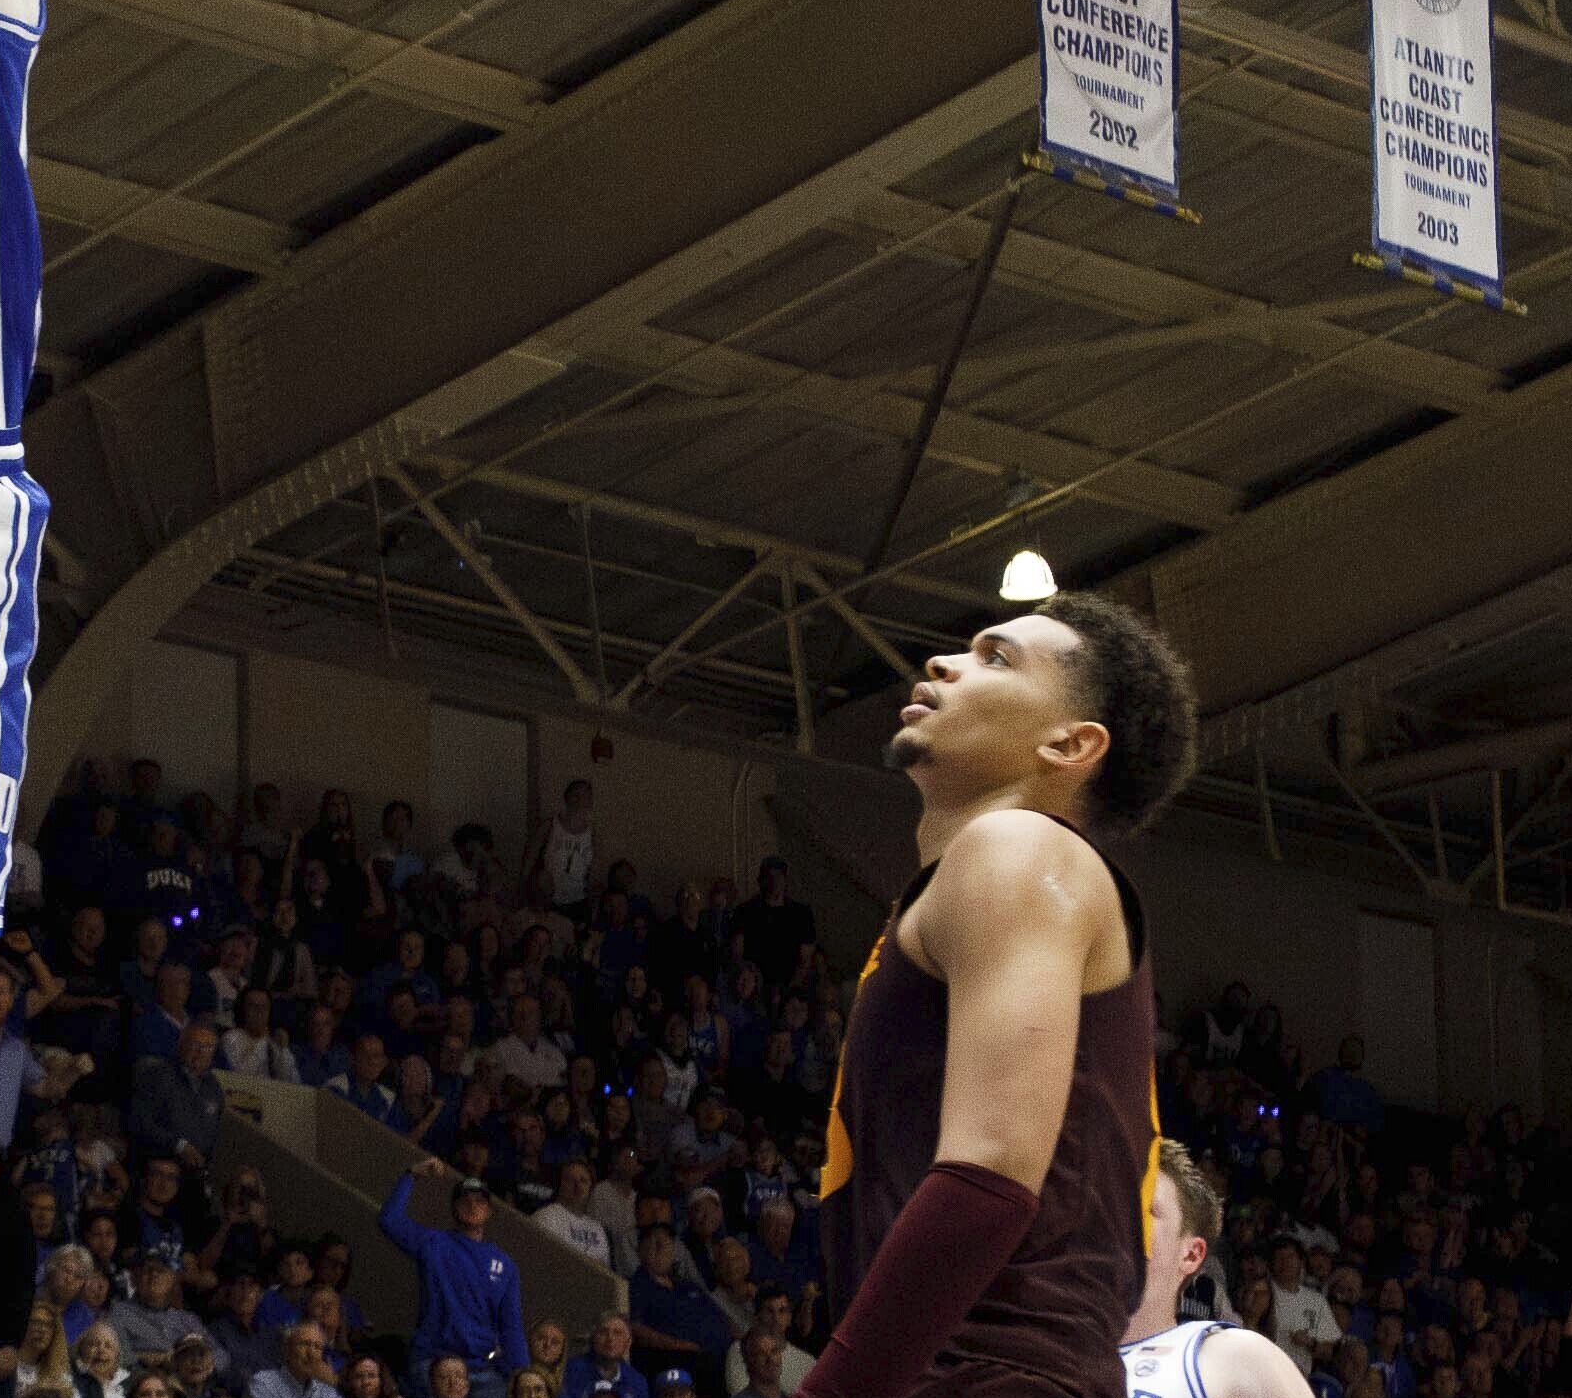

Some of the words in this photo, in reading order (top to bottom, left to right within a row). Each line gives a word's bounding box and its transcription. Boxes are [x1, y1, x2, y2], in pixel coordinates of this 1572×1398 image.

[1054, 25, 1163, 87] CHAMPIONS
[1395, 37, 1474, 85] ATLANTIC
[1074, 72, 1146, 111] TOURNAMENT
[1409, 74, 1462, 114] COAST
[1089, 111, 1139, 151] 2002
[1380, 97, 1490, 157] CONFERENCE
[1385, 134, 1487, 188] CHAMPIONS
[1405, 171, 1471, 210] TOURNAMENT
[1418, 211, 1458, 246] 2003
